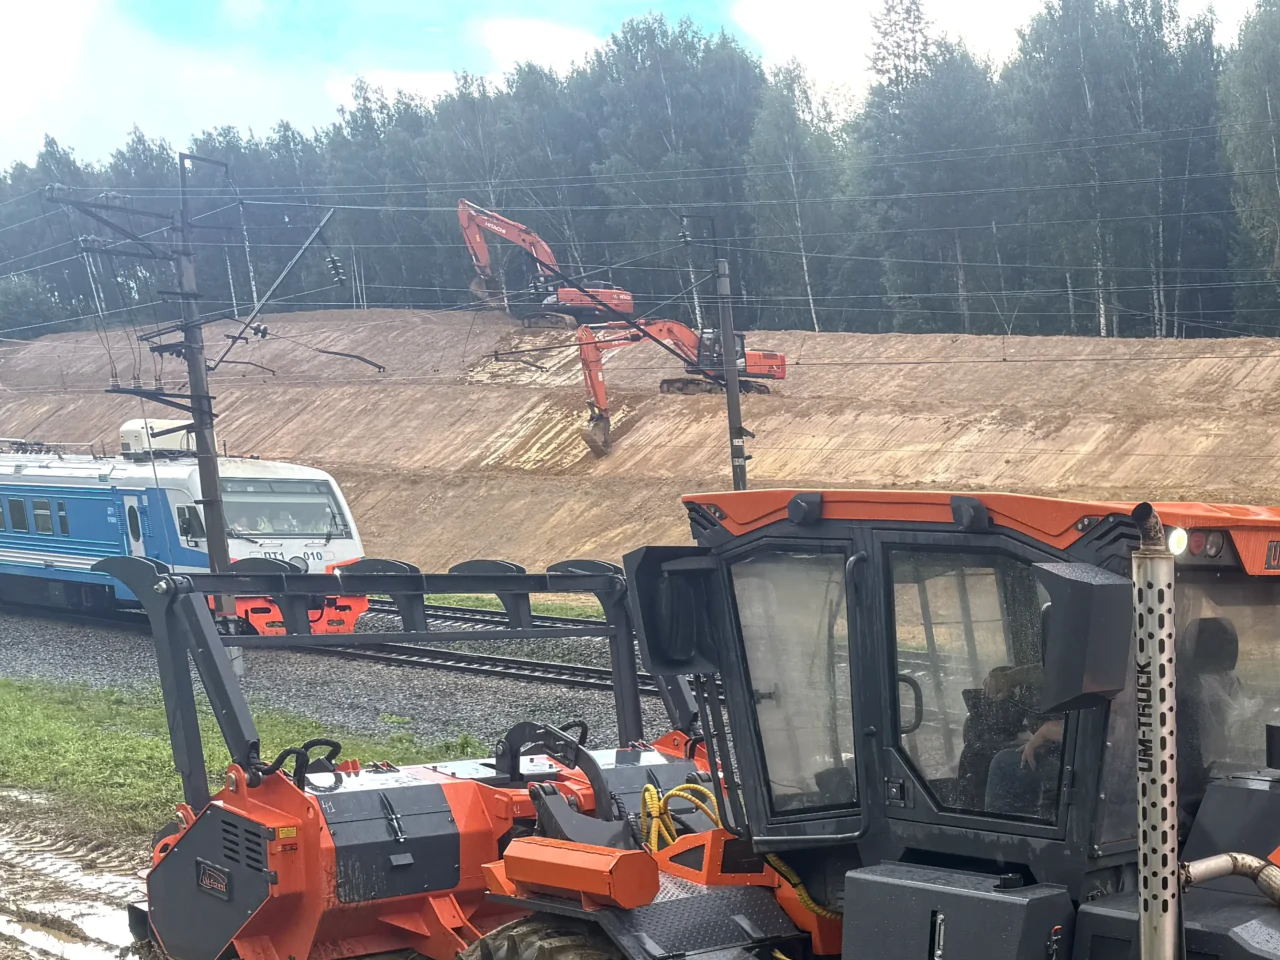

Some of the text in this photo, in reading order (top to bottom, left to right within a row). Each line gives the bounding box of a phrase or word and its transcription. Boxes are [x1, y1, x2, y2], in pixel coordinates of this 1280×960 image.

[303, 551, 323, 561] 010
[1136, 660, 1154, 773] UM-TRUCK
[321, 800, 336, 813] 41
